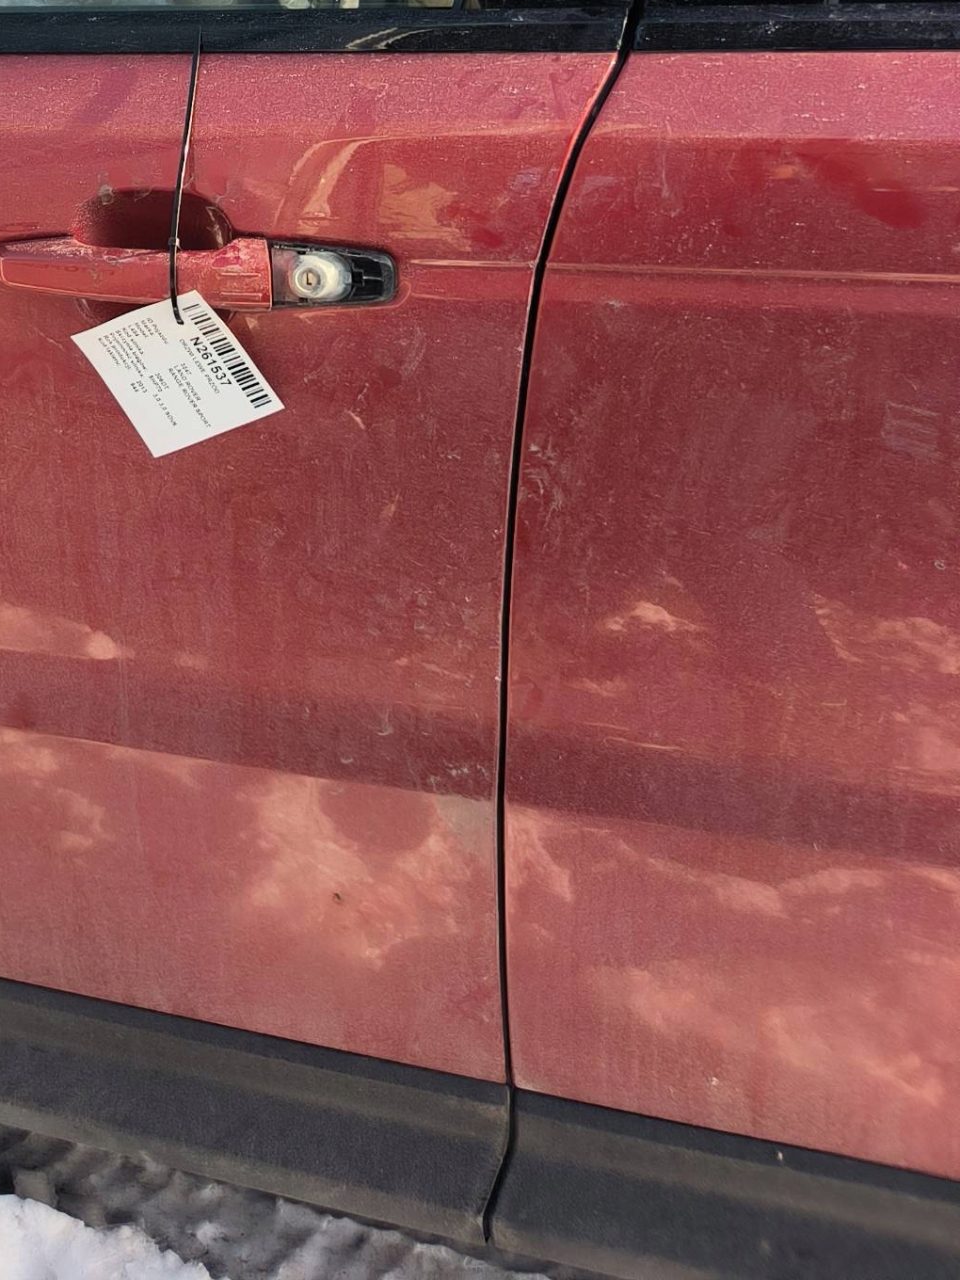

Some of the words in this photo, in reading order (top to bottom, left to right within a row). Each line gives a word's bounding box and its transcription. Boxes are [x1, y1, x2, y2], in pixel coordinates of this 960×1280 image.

[172, 364, 188, 381] LAND
[183, 380, 203, 401] ROVER
[190, 337, 232, 386] N261537
[166, 367, 185, 388] RANGE
[180, 387, 199, 409] ROVER
[193, 407, 212, 428] SPORT
